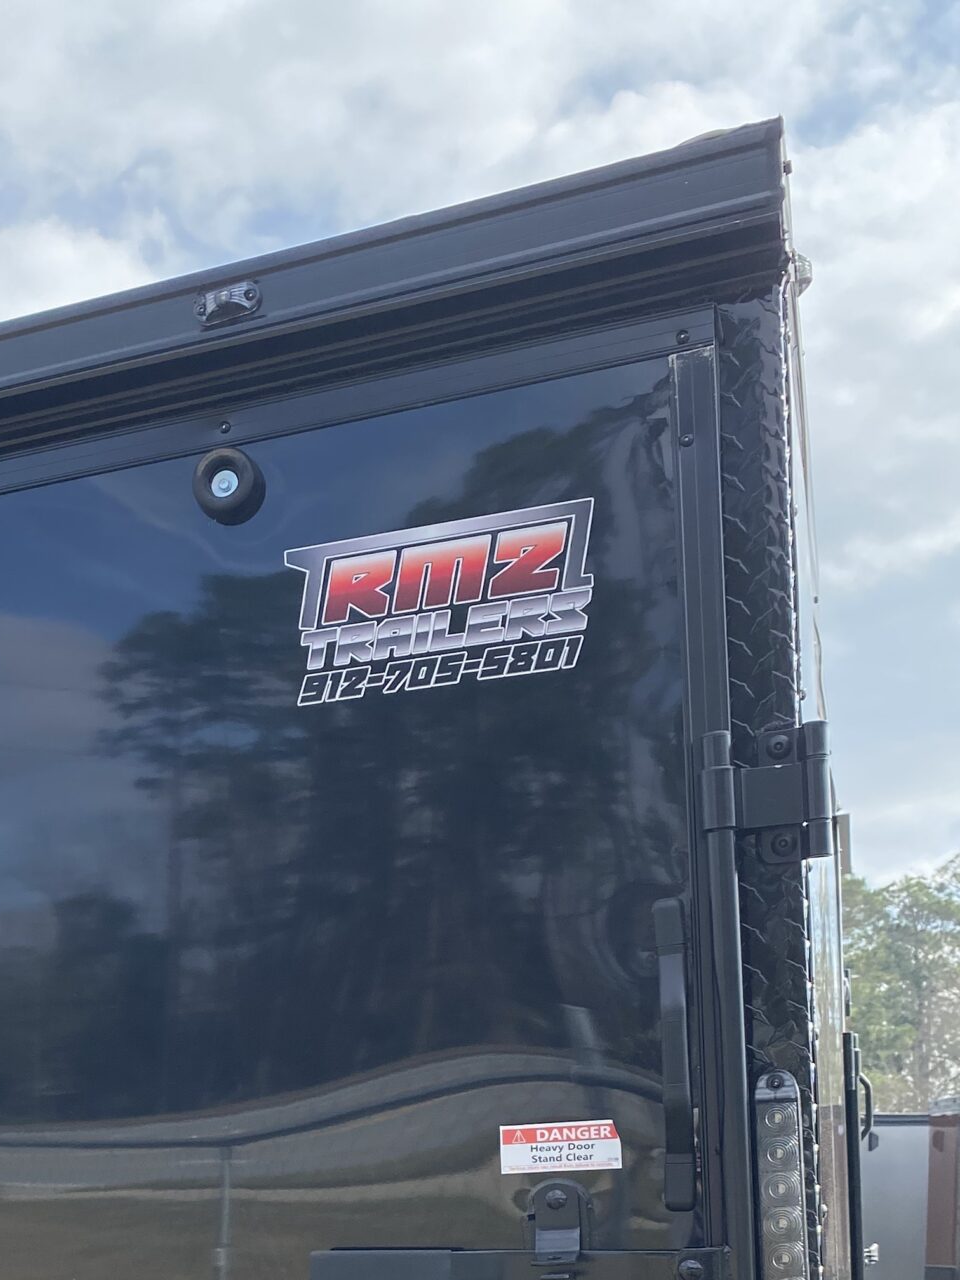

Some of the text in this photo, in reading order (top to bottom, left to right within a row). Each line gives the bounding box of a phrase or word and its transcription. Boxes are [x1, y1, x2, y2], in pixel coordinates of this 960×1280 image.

[300, 589, 592, 670] TRAILERS
[297, 635, 584, 706] 912-705-5801
[536, 1125, 612, 1141] DANGER
[530, 1142, 595, 1153] Heavy Door
[532, 1153, 594, 1163] Stand Clear
